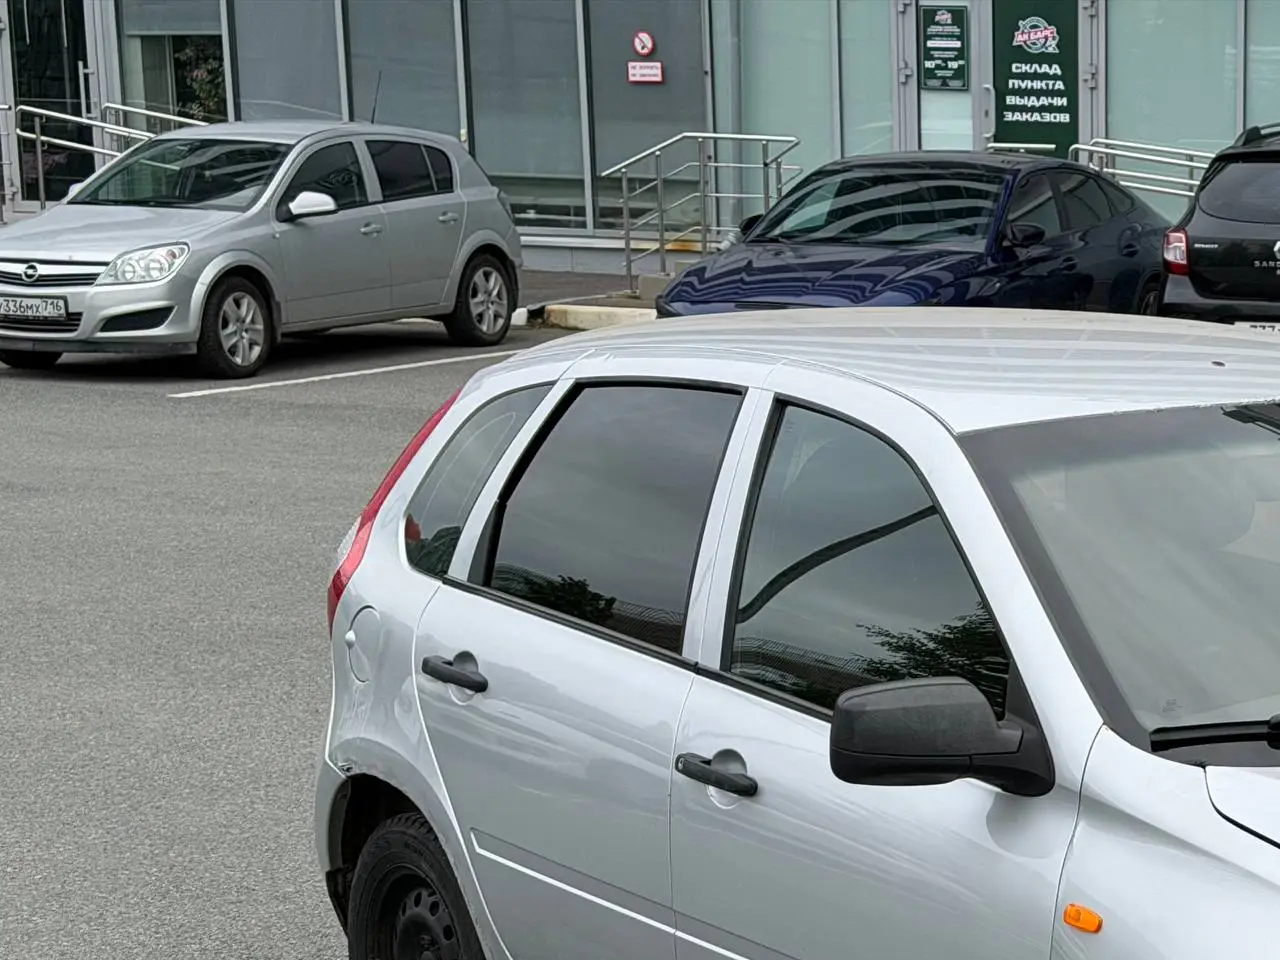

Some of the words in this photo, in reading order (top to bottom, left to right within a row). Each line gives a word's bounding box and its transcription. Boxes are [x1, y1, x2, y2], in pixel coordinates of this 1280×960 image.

[1011, 63, 1062, 75] СКЛАД
[1008, 79, 1065, 90] ПУНКТА
[1005, 95, 1068, 107] ВЫДАЧИ
[1003, 111, 1070, 123] ЗАКАЗОВ
[42, 300, 63, 312] 716
